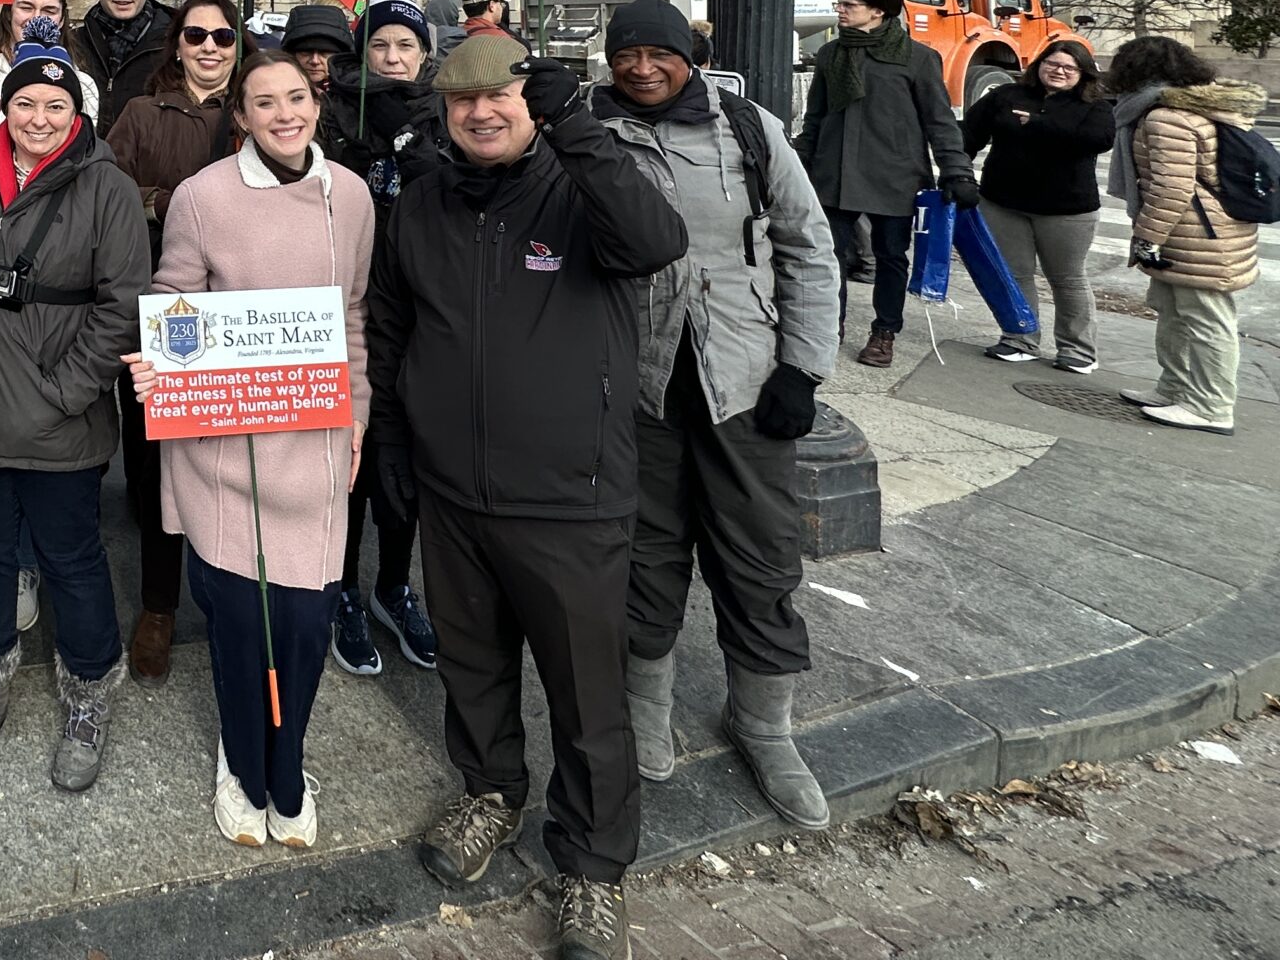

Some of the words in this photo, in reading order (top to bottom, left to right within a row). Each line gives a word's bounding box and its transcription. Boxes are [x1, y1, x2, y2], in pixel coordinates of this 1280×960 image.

[221, 315, 243, 326] THE
[246, 309, 316, 325] BASILICA
[320, 312, 334, 321] OF
[170, 323, 196, 338] 230
[223, 329, 275, 347] SAINT
[281, 326, 332, 344] MARY
[150, 404, 187, 418] treat
[191, 403, 234, 416] every
[238, 399, 288, 413] human
